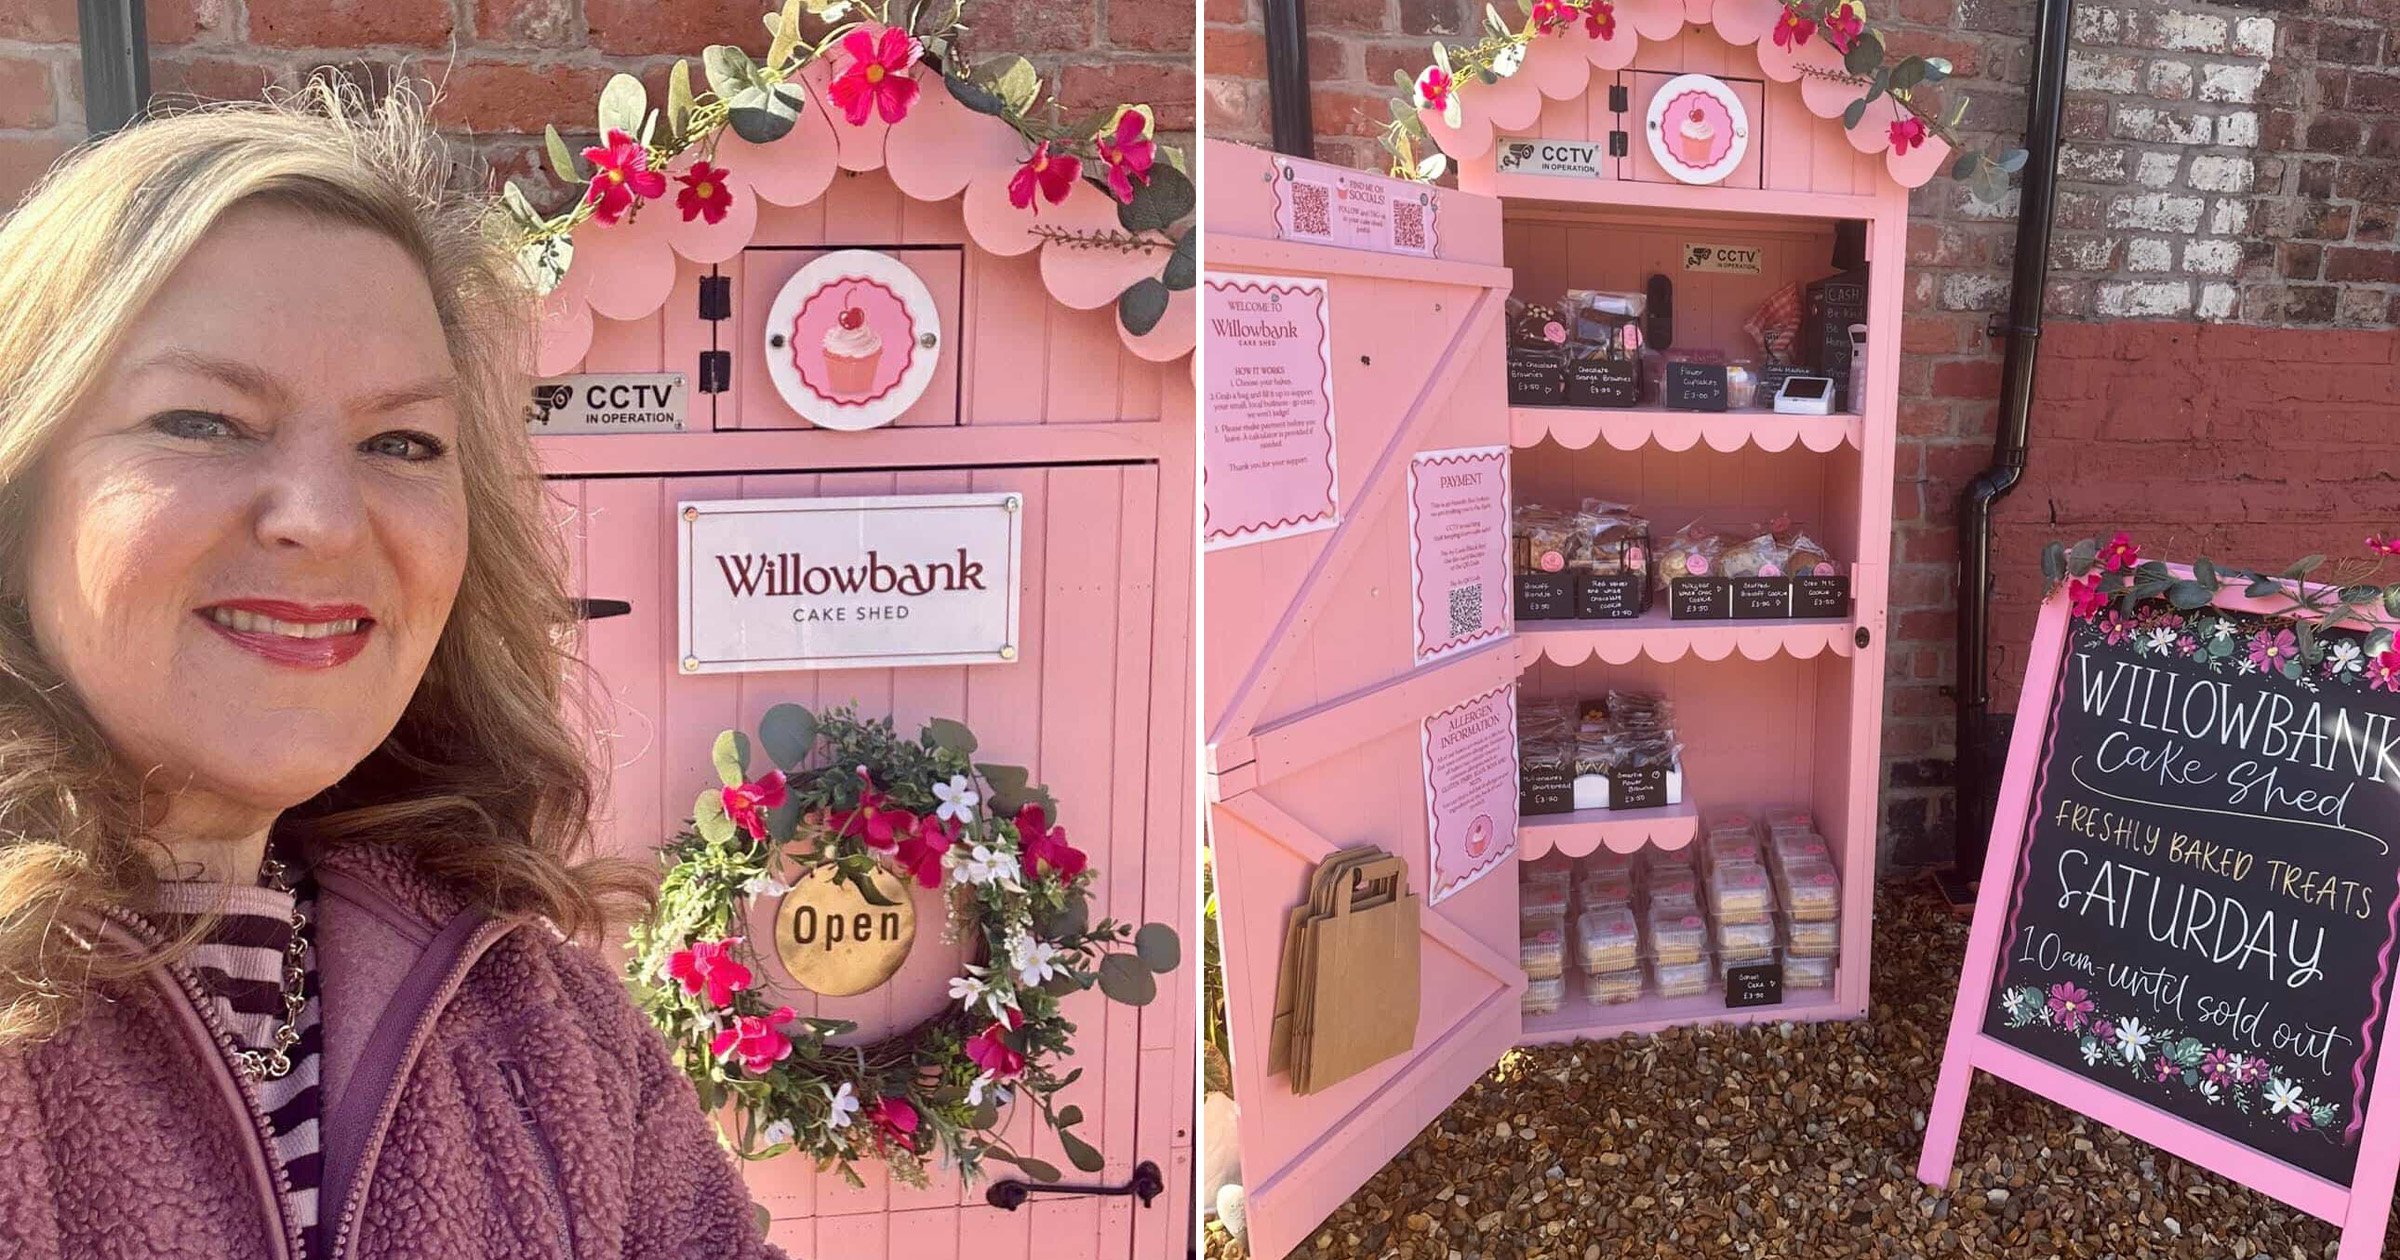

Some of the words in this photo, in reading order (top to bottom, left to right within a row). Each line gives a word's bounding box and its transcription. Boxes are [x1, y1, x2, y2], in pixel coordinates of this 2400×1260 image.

[1542, 146, 1593, 163] CCTV
[1551, 164, 1595, 173] OPERATION
[1717, 249, 1756, 263] CCTV
[1829, 287, 1859, 302] CASH
[1228, 301, 1270, 312] WELCOME
[1212, 318, 1298, 340] Willowbank
[1511, 370, 1543, 378] Brownies
[1603, 374, 1631, 383] Brownies
[586, 384, 673, 410] CCTV
[586, 412, 601, 424] IN
[602, 411, 675, 424] OPERATION
[1440, 472, 1483, 488] PAYMENT
[715, 548, 987, 598] Willowbank
[792, 607, 847, 623] CAKE
[856, 606, 910, 621] SHED
[1448, 703, 1493, 732] ALLERGEN
[2075, 652, 2400, 783] WILLOWBANK
[1441, 712, 1500, 749] INFORMATION
[2096, 730, 2218, 786] Cake
[2226, 761, 2355, 828] Shed
[2055, 800, 2160, 856] FRESHLY
[2168, 831, 2254, 882] BAKED
[2267, 860, 2373, 919] TREATS
[793, 905, 899, 951] Open
[2057, 848, 2325, 989] SATURDAY
[2196, 994, 2270, 1048] sold
[2272, 1021, 2353, 1076] out
